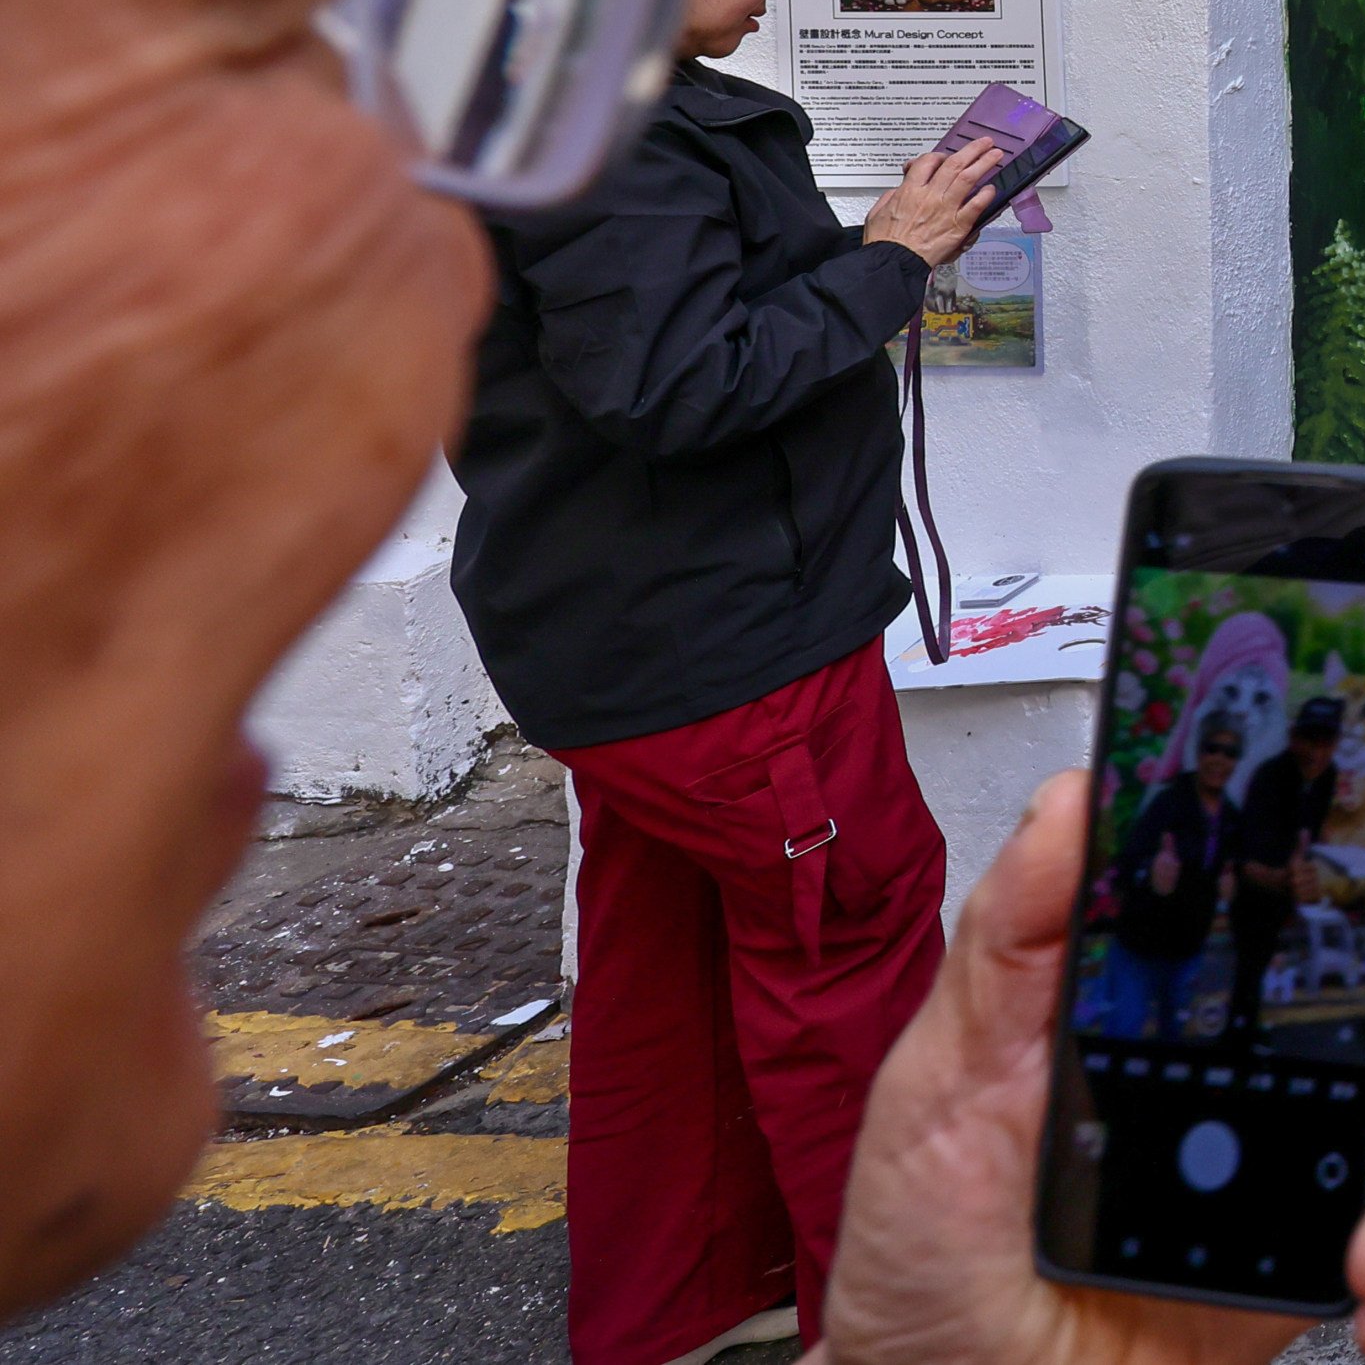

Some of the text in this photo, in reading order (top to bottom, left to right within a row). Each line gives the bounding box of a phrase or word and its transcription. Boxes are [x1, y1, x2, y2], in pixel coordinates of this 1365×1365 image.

[865, 30, 894, 38] Mural
[897, 30, 933, 39] Design
[937, 30, 984, 39] Concept
